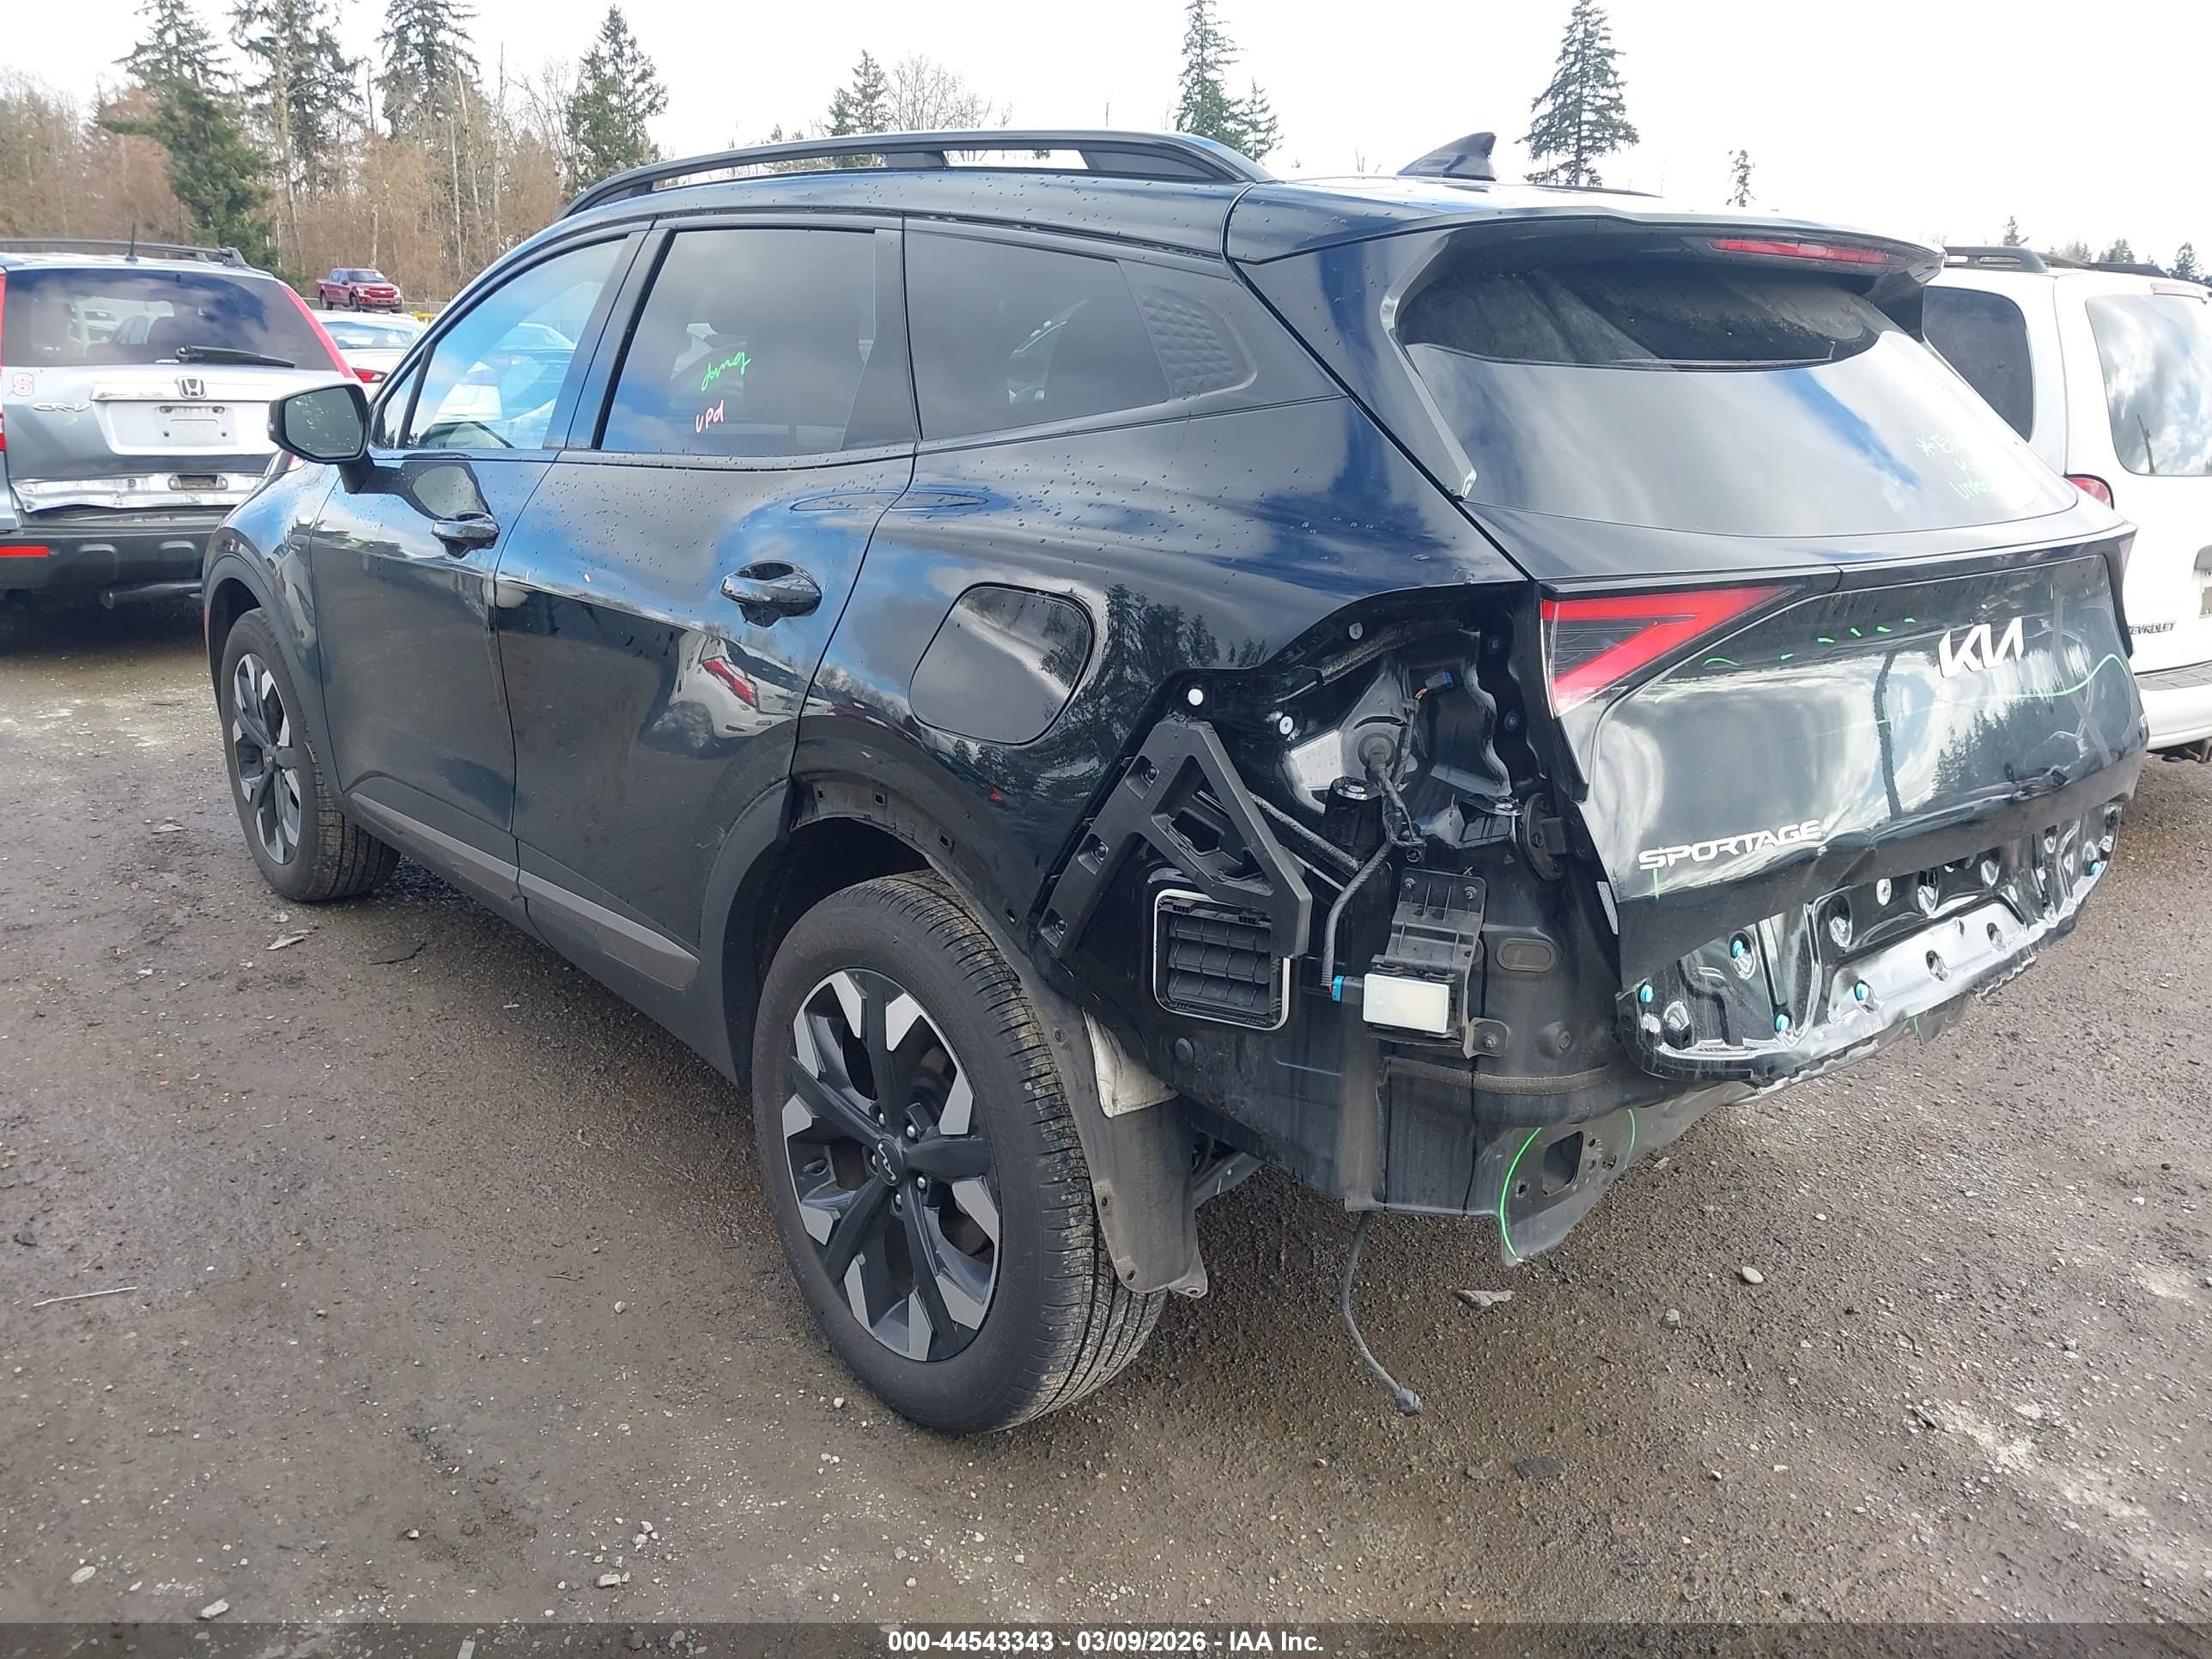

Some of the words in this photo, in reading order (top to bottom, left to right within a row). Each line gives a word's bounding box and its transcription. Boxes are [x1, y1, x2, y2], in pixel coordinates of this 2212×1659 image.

[1938, 617, 2025, 678] KIA
[2128, 621, 2176, 635] EVROLET
[1638, 819, 1823, 871] SPORTAGE
